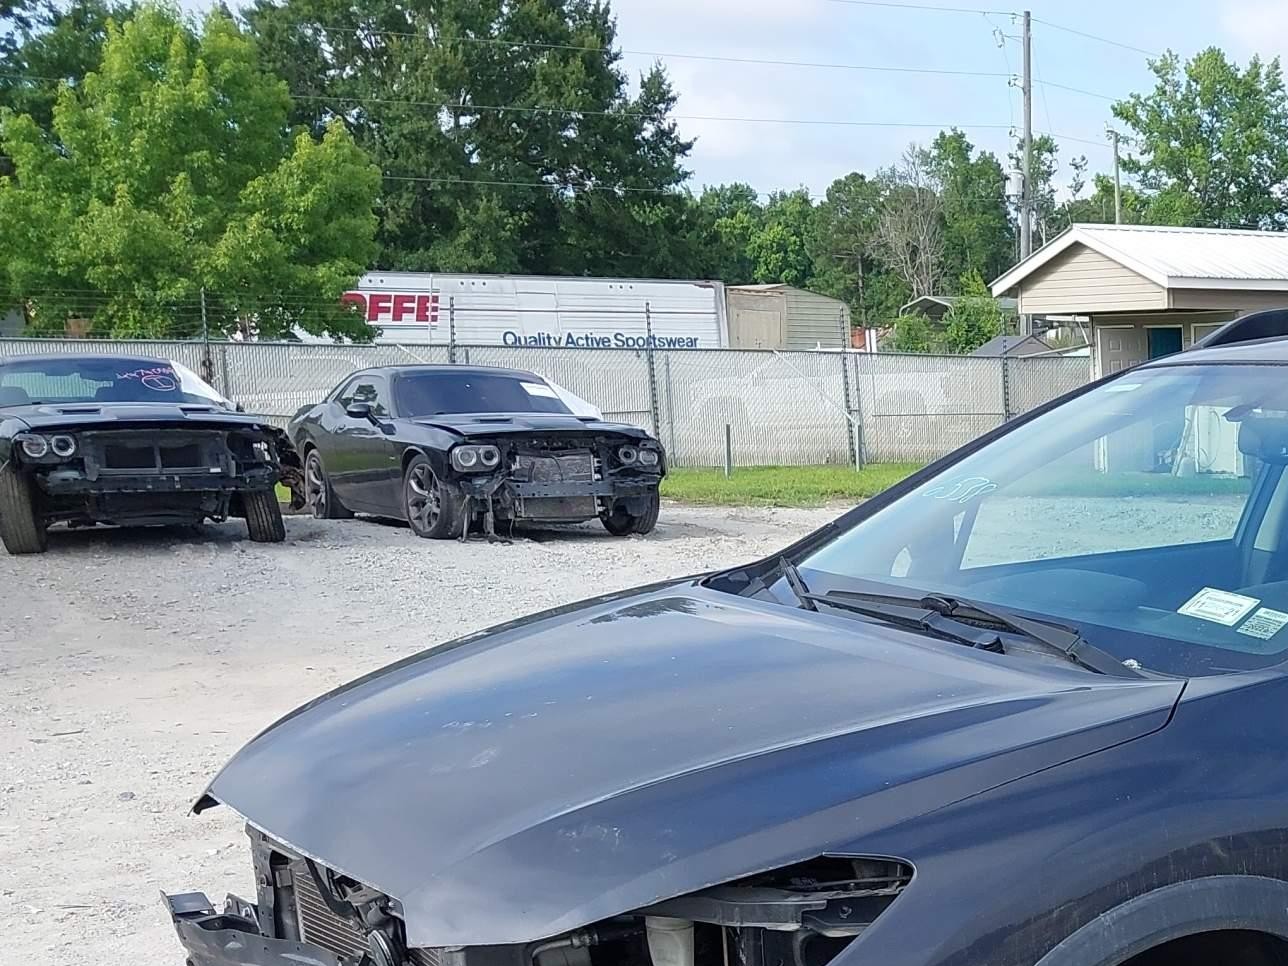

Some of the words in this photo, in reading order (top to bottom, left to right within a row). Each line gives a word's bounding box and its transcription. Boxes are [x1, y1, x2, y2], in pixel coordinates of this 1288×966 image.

[502, 331, 561, 347] Quality
[565, 332, 611, 348] Active
[613, 332, 699, 348] Sportswear
